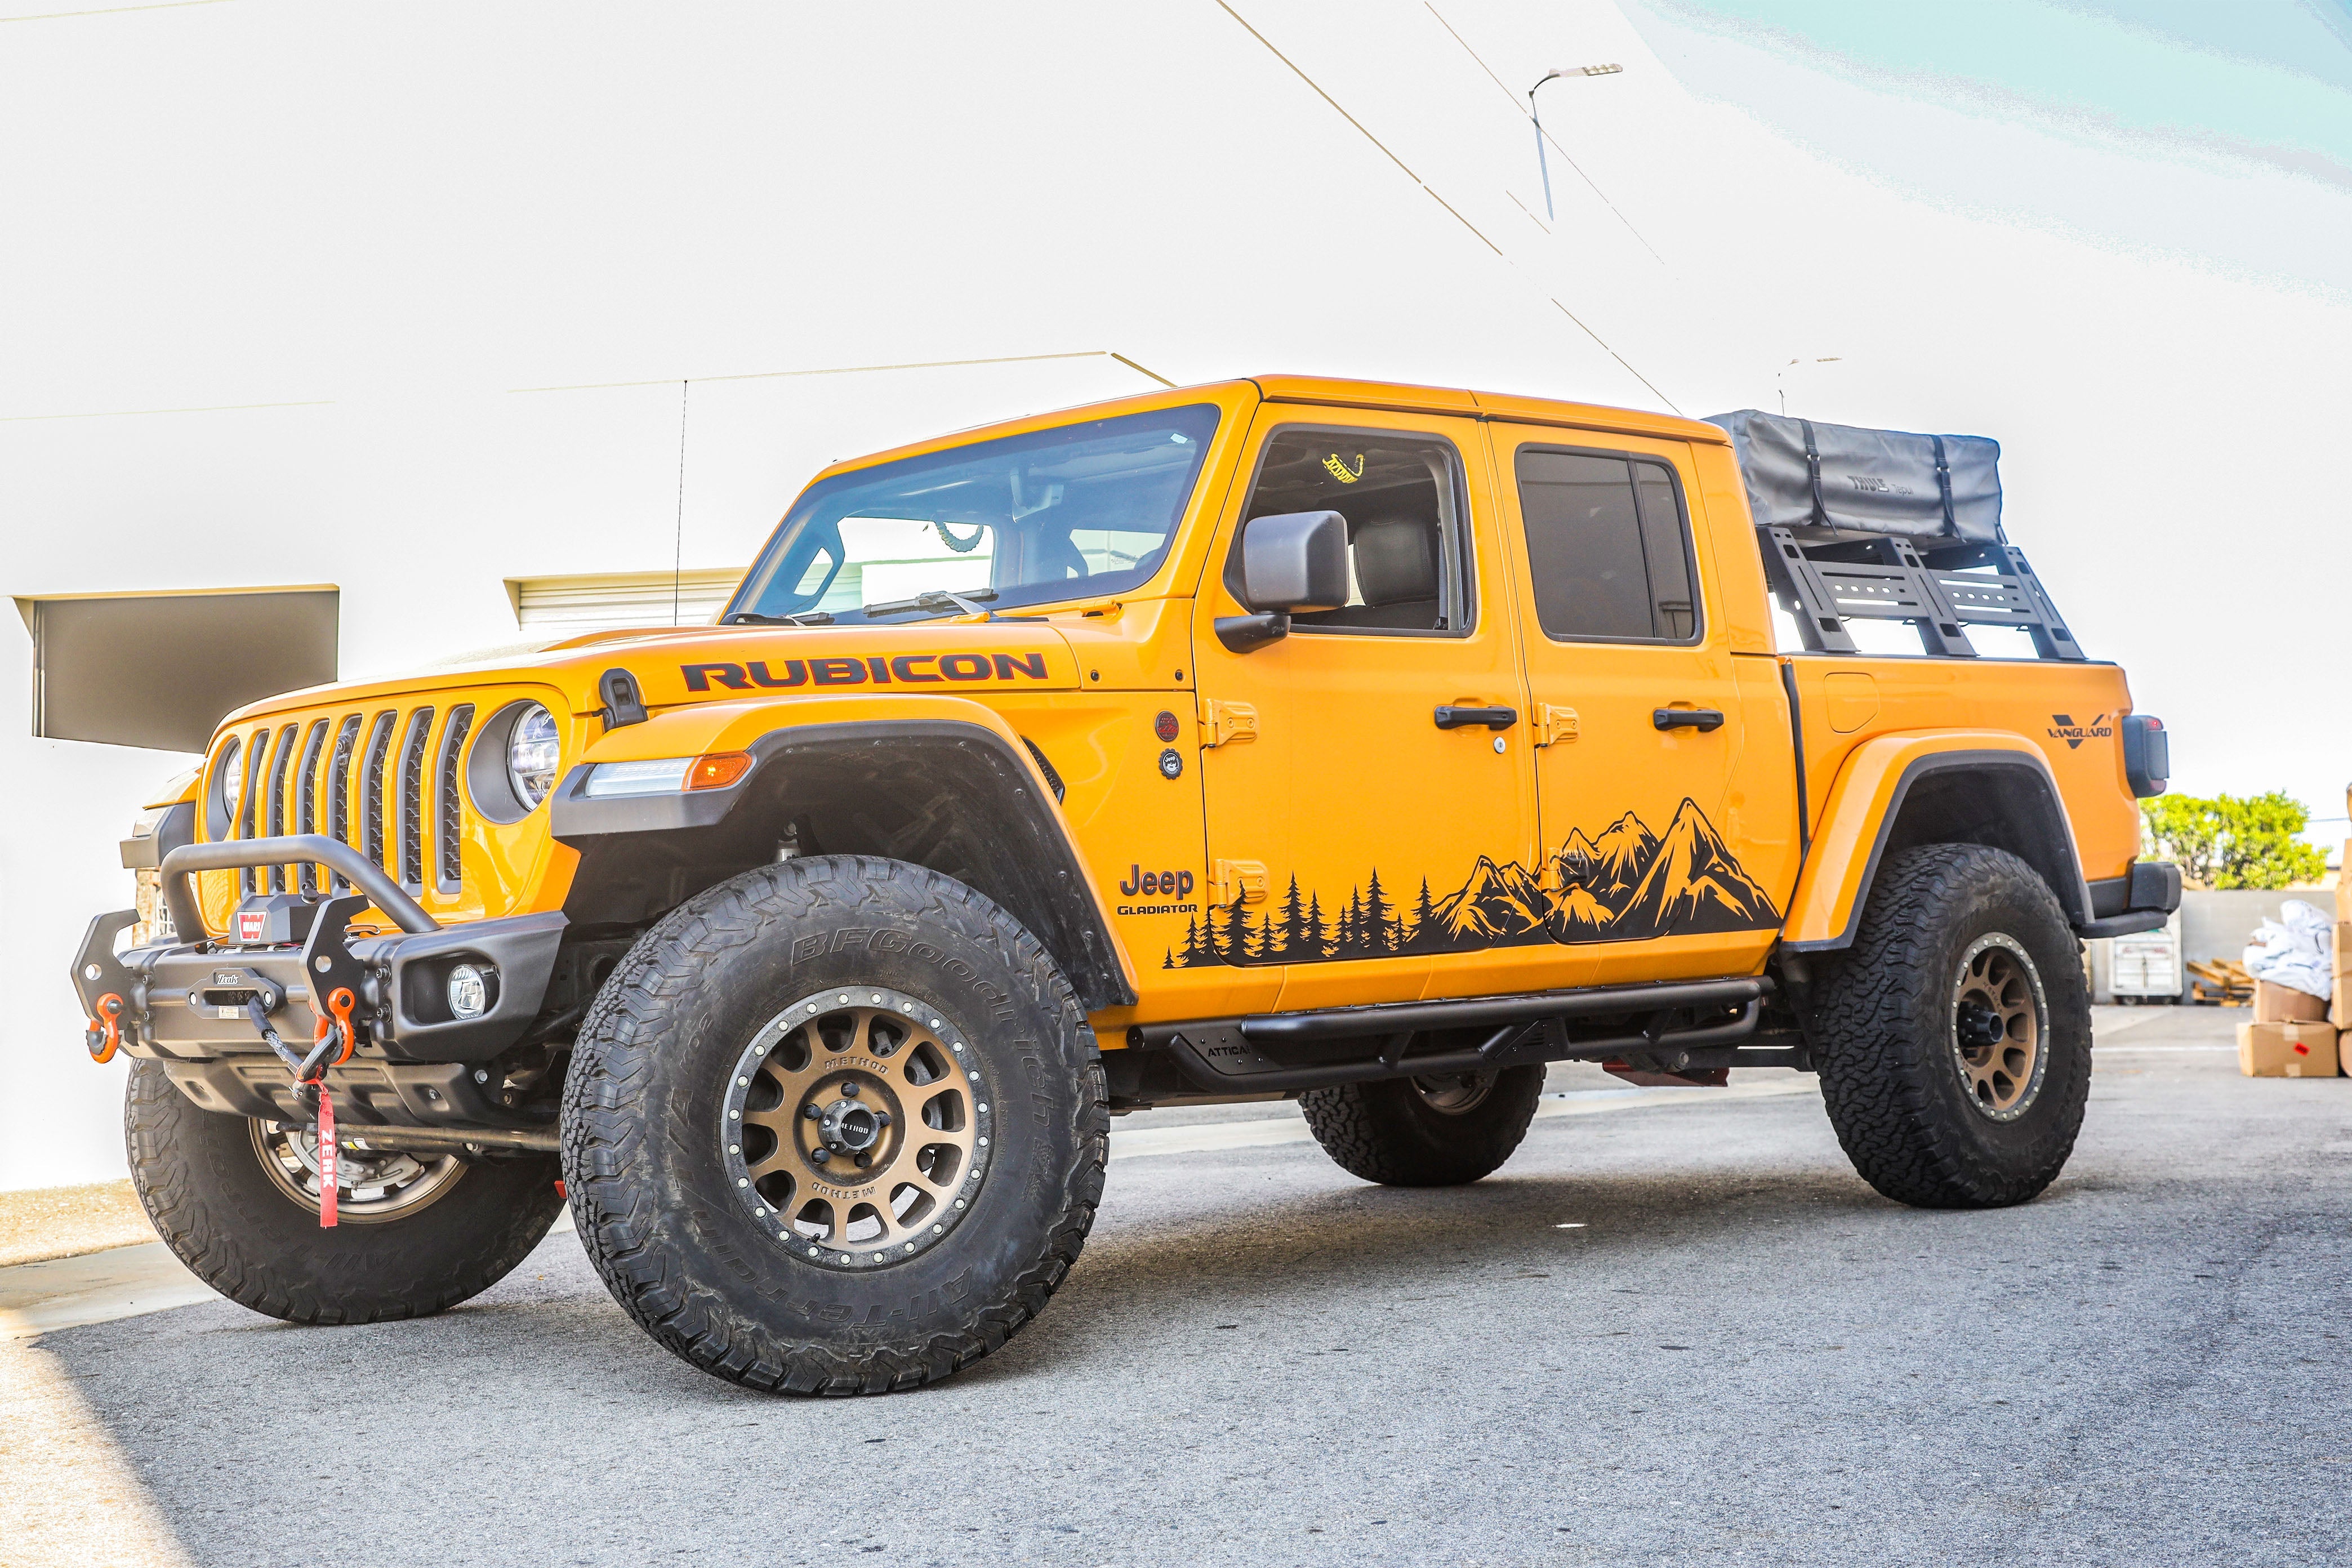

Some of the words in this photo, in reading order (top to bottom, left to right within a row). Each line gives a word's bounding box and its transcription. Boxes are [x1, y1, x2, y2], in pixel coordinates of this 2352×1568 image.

[1847, 475, 1888, 492] THULE
[680, 653, 1048, 692] RUBICON
[2047, 727, 2112, 738] VANGUARD
[1120, 864, 1194, 900] Jeep
[1117, 904, 1197, 915] GLADIATOR
[217, 974, 239, 985] Zeak
[825, 1057, 888, 1075] METHOD
[322, 1129, 334, 1188] ZEAK
[812, 1182, 876, 1200] METHOD
